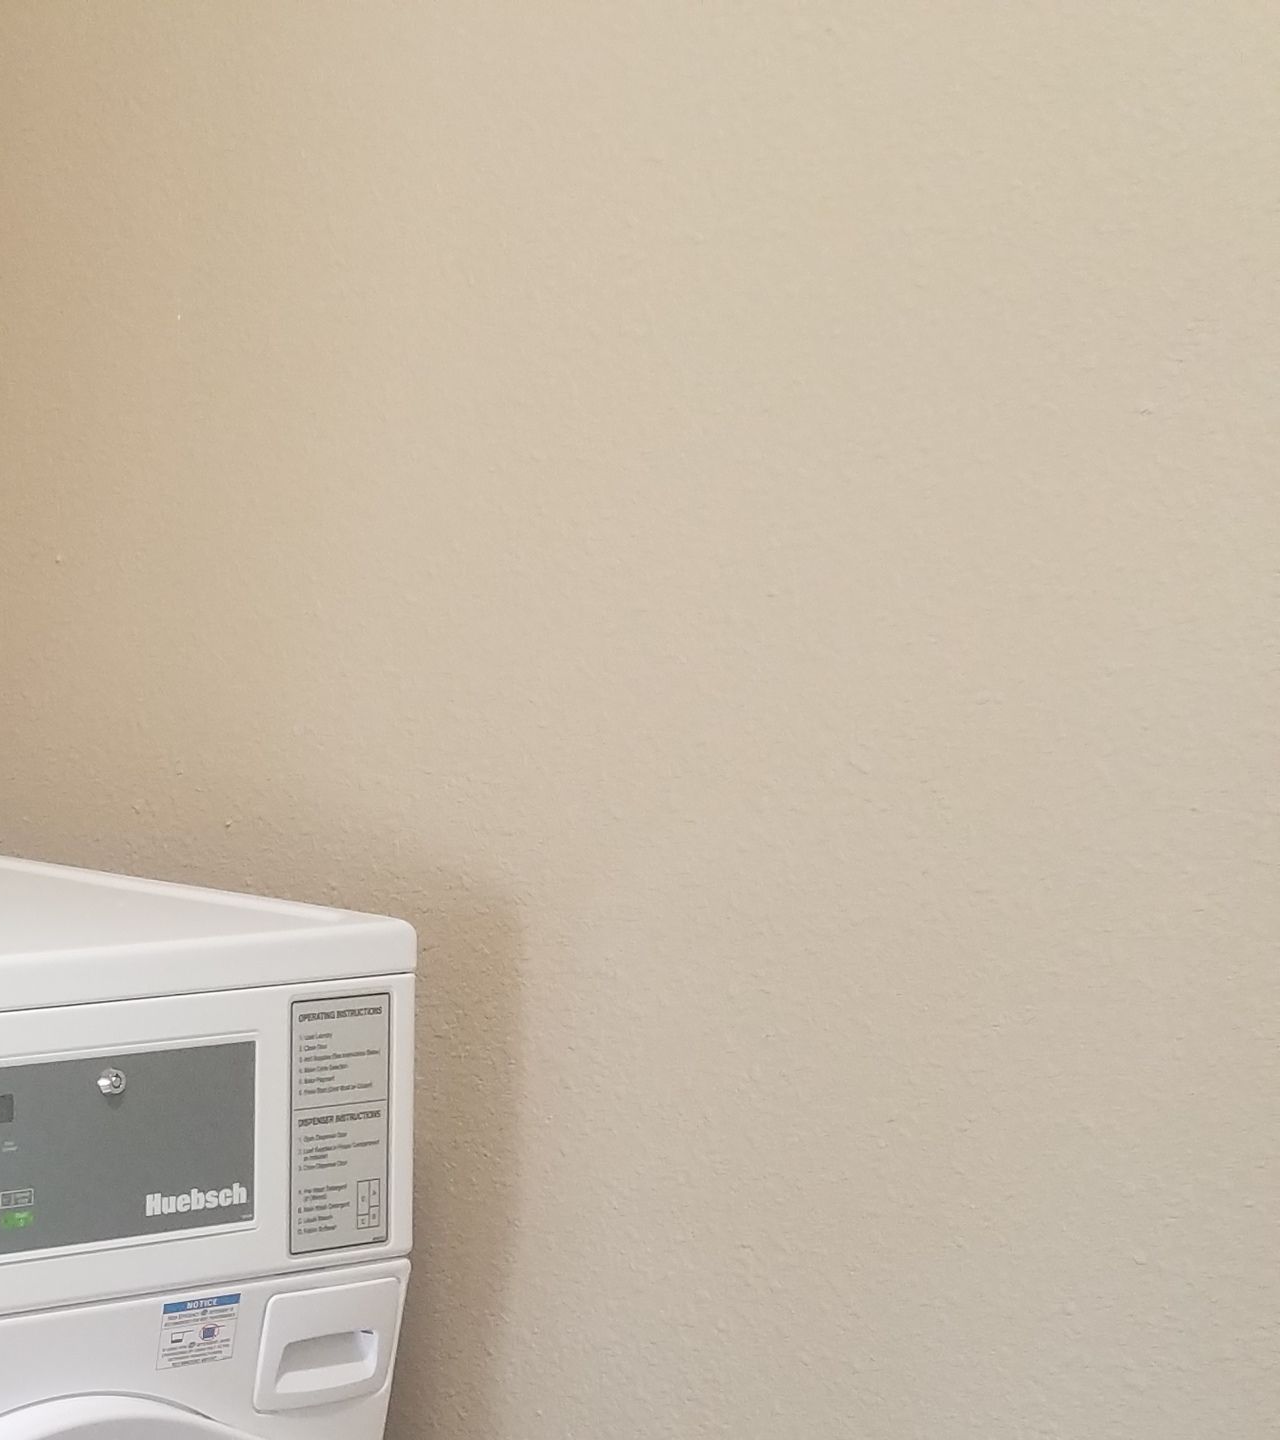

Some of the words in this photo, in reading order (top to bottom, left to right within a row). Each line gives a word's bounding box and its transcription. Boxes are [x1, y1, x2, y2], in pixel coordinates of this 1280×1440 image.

[298, 1009, 336, 1022] OPERATING
[336, 1006, 383, 1019] INSTRUCTIONS
[335, 1110, 382, 1122] INSTRUCTIONS
[145, 1182, 248, 1217] Huebsch
[186, 1298, 218, 1309] NOTICE
